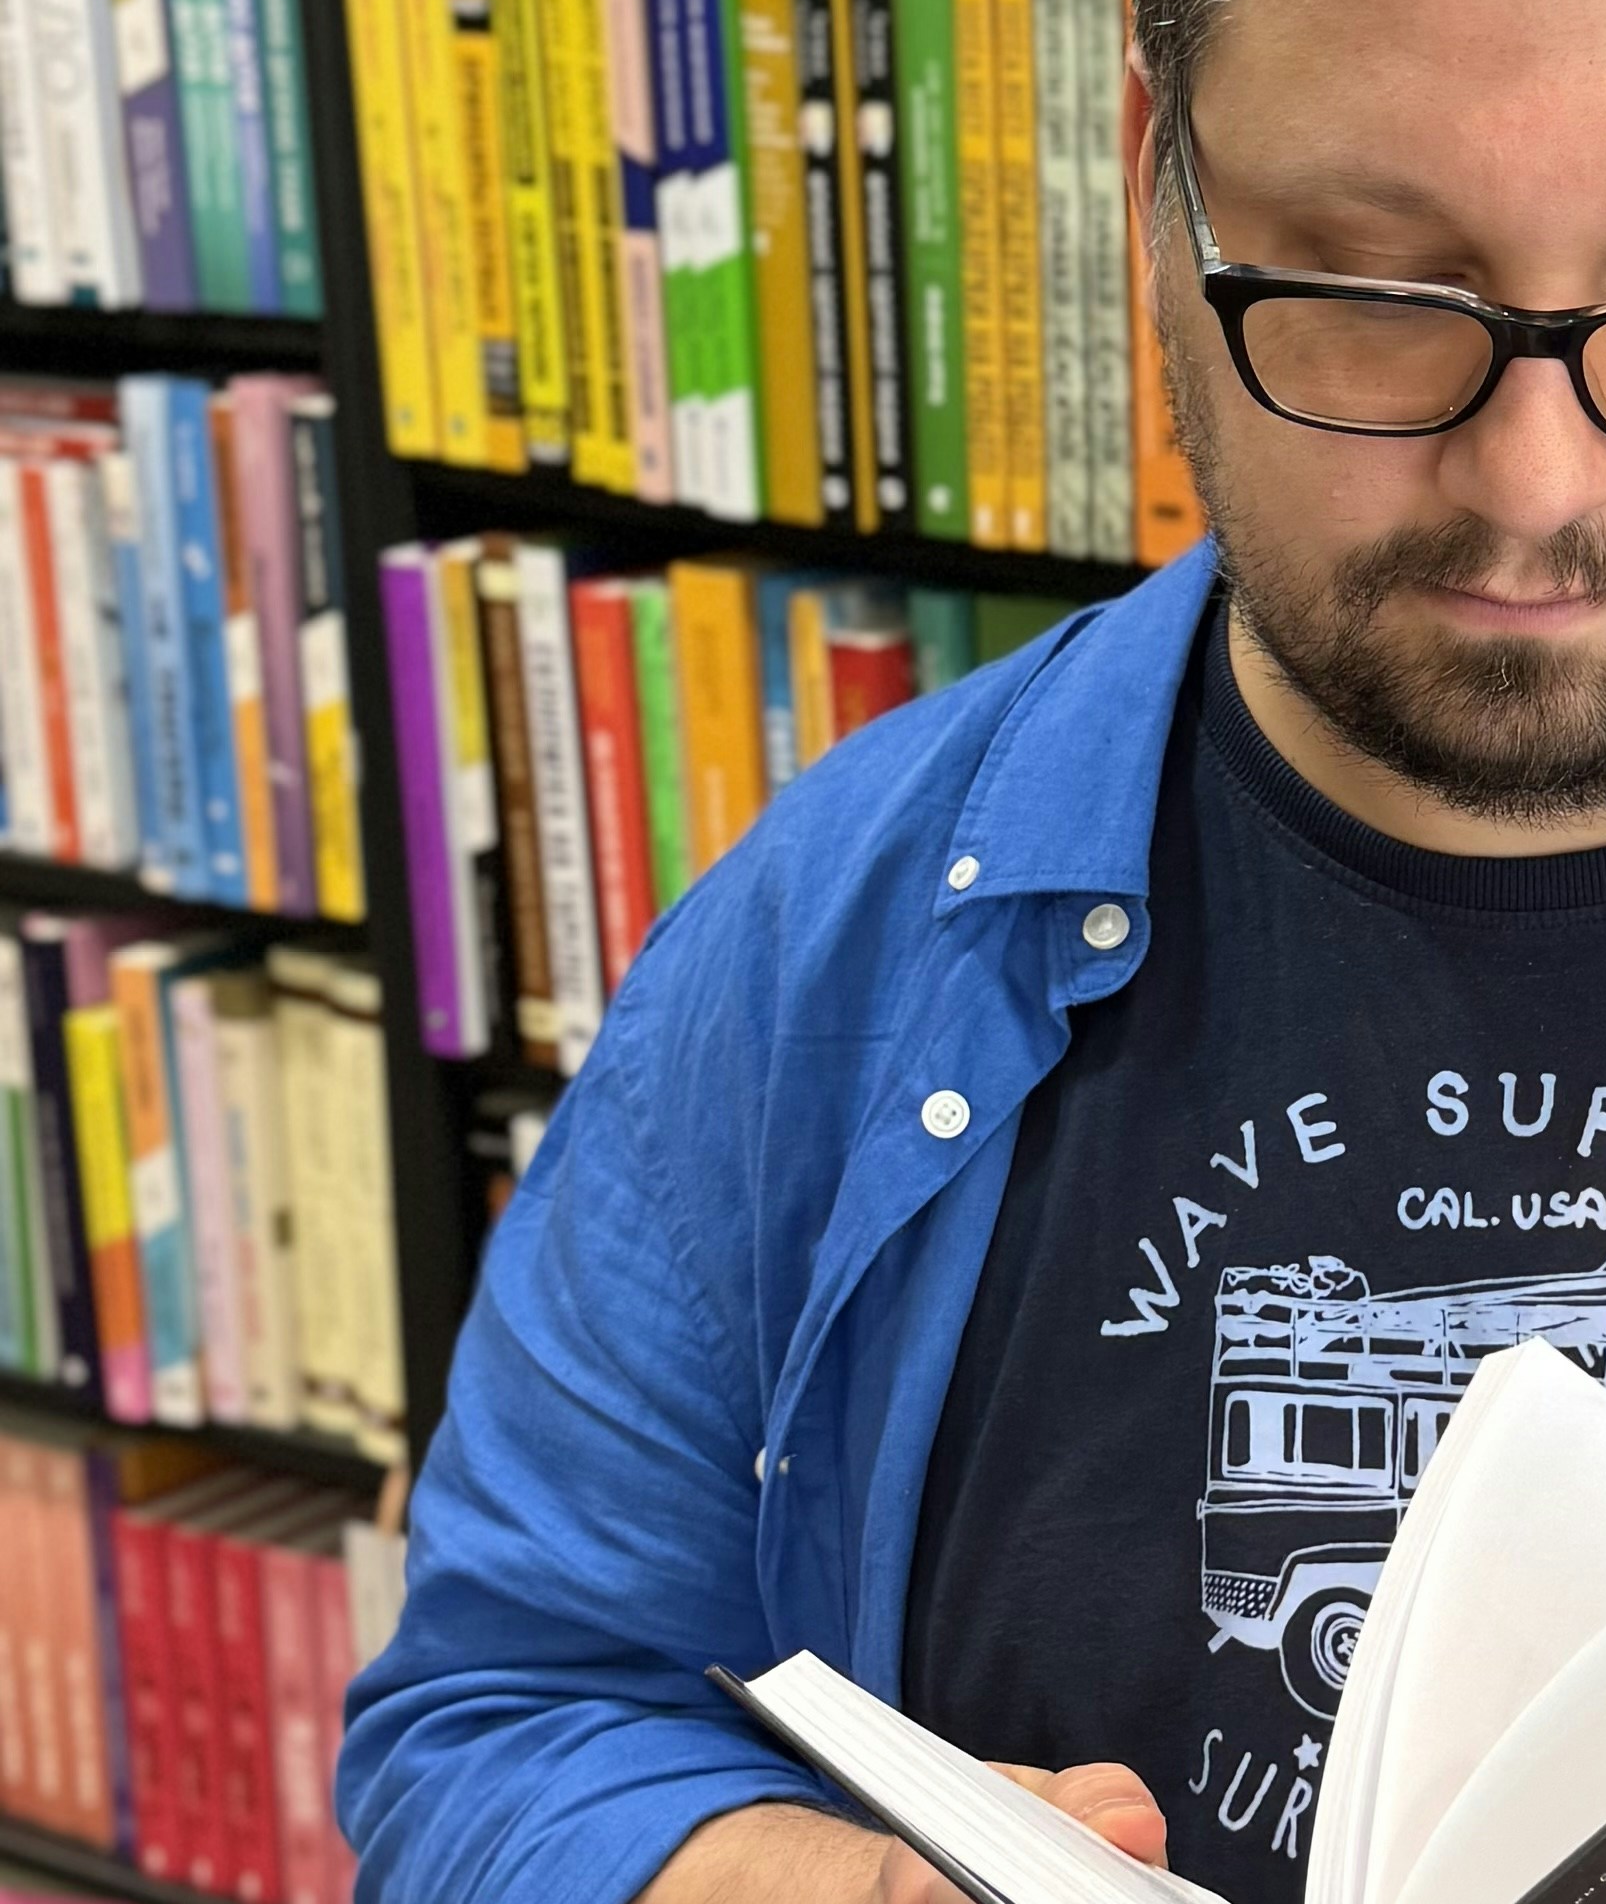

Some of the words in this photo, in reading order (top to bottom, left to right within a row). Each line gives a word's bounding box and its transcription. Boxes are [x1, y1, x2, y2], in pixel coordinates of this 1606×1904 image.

[1100, 1092, 1347, 1339] WAVE
[1397, 1187, 1501, 1230] CAL.
[1189, 1729, 1314, 1859] SUR
